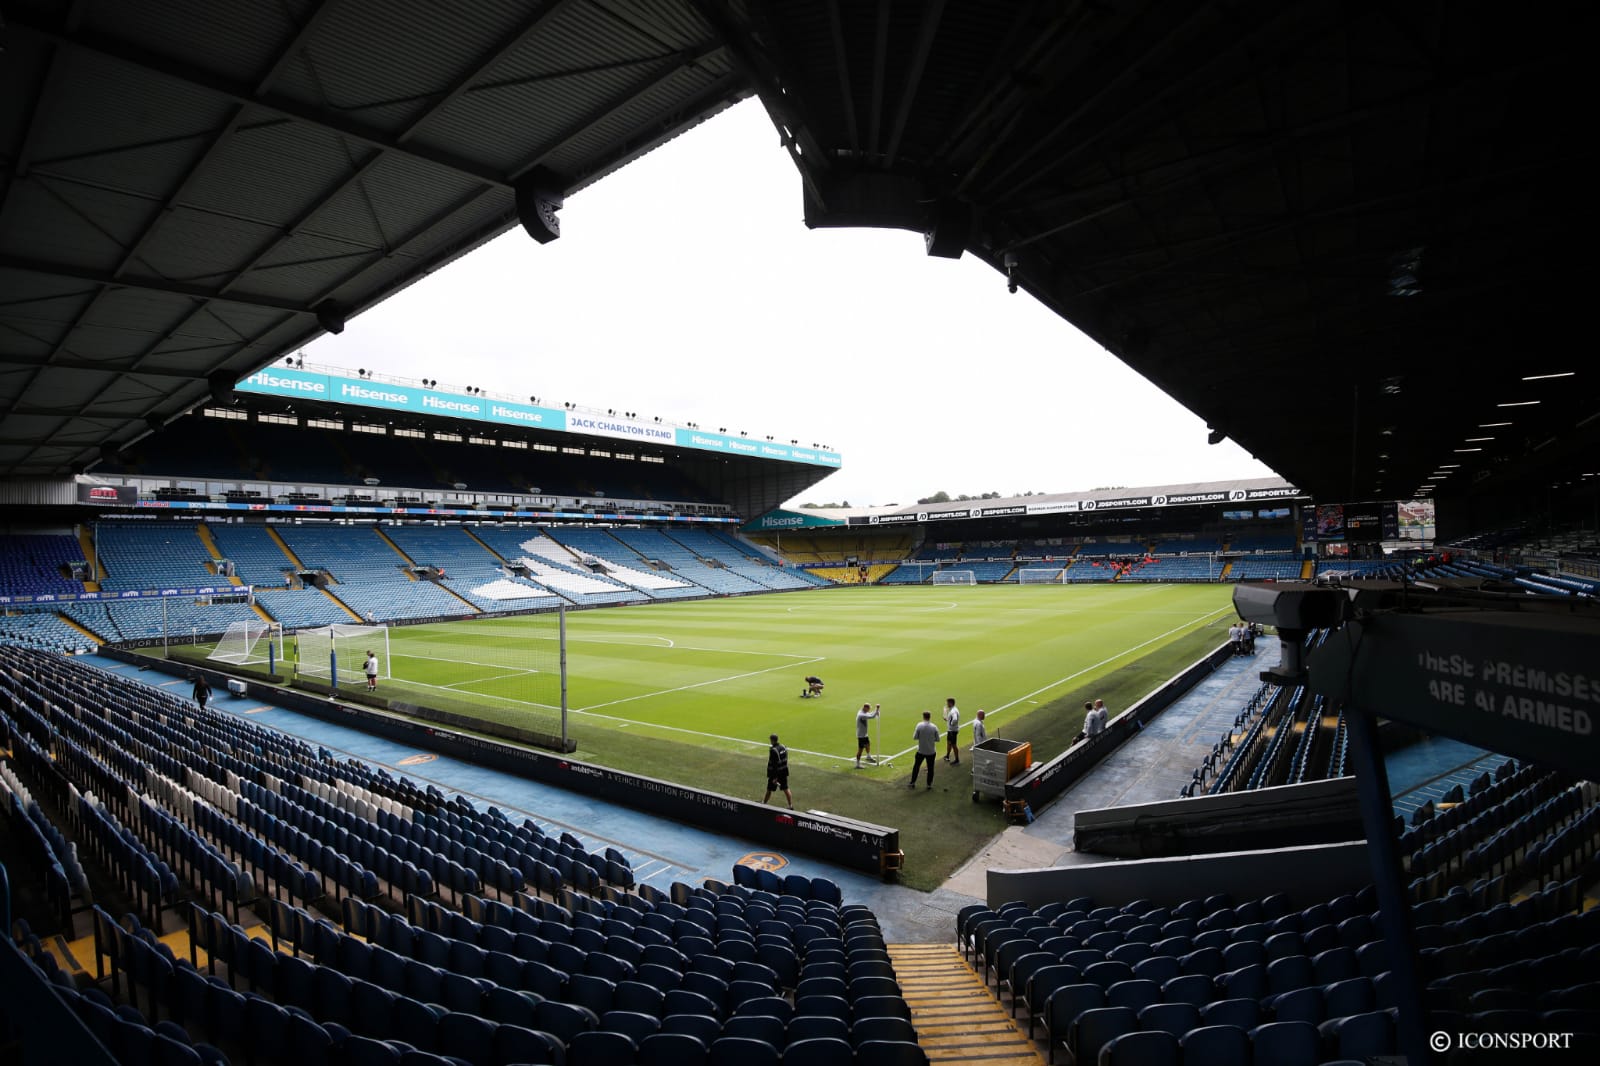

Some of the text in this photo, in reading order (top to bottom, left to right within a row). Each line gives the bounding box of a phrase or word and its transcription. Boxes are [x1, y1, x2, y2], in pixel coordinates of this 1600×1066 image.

[247, 372, 325, 392] Hisense
[341, 384, 408, 404] Hisense
[422, 396, 480, 413] Hisense
[492, 405, 542, 422] Hisense
[571, 417, 672, 440] JACK CHARLTON STAND
[692, 435, 723, 448] Hisense
[1169, 494, 1225, 503] JDSPORTS.COM
[1248, 489, 1301, 498] JDSPORTS.C
[1097, 499, 1148, 508] JDSPORTS.COM
[762, 515, 804, 527] Hisense
[1429, 679, 1466, 705] ARE
[614, 774, 641, 787] VEHICLE
[642, 781, 678, 797] SOLUTION
[679, 790, 695, 801] FOR
[696, 795, 739, 812] EVERYONE
[861, 834, 868, 844] A
